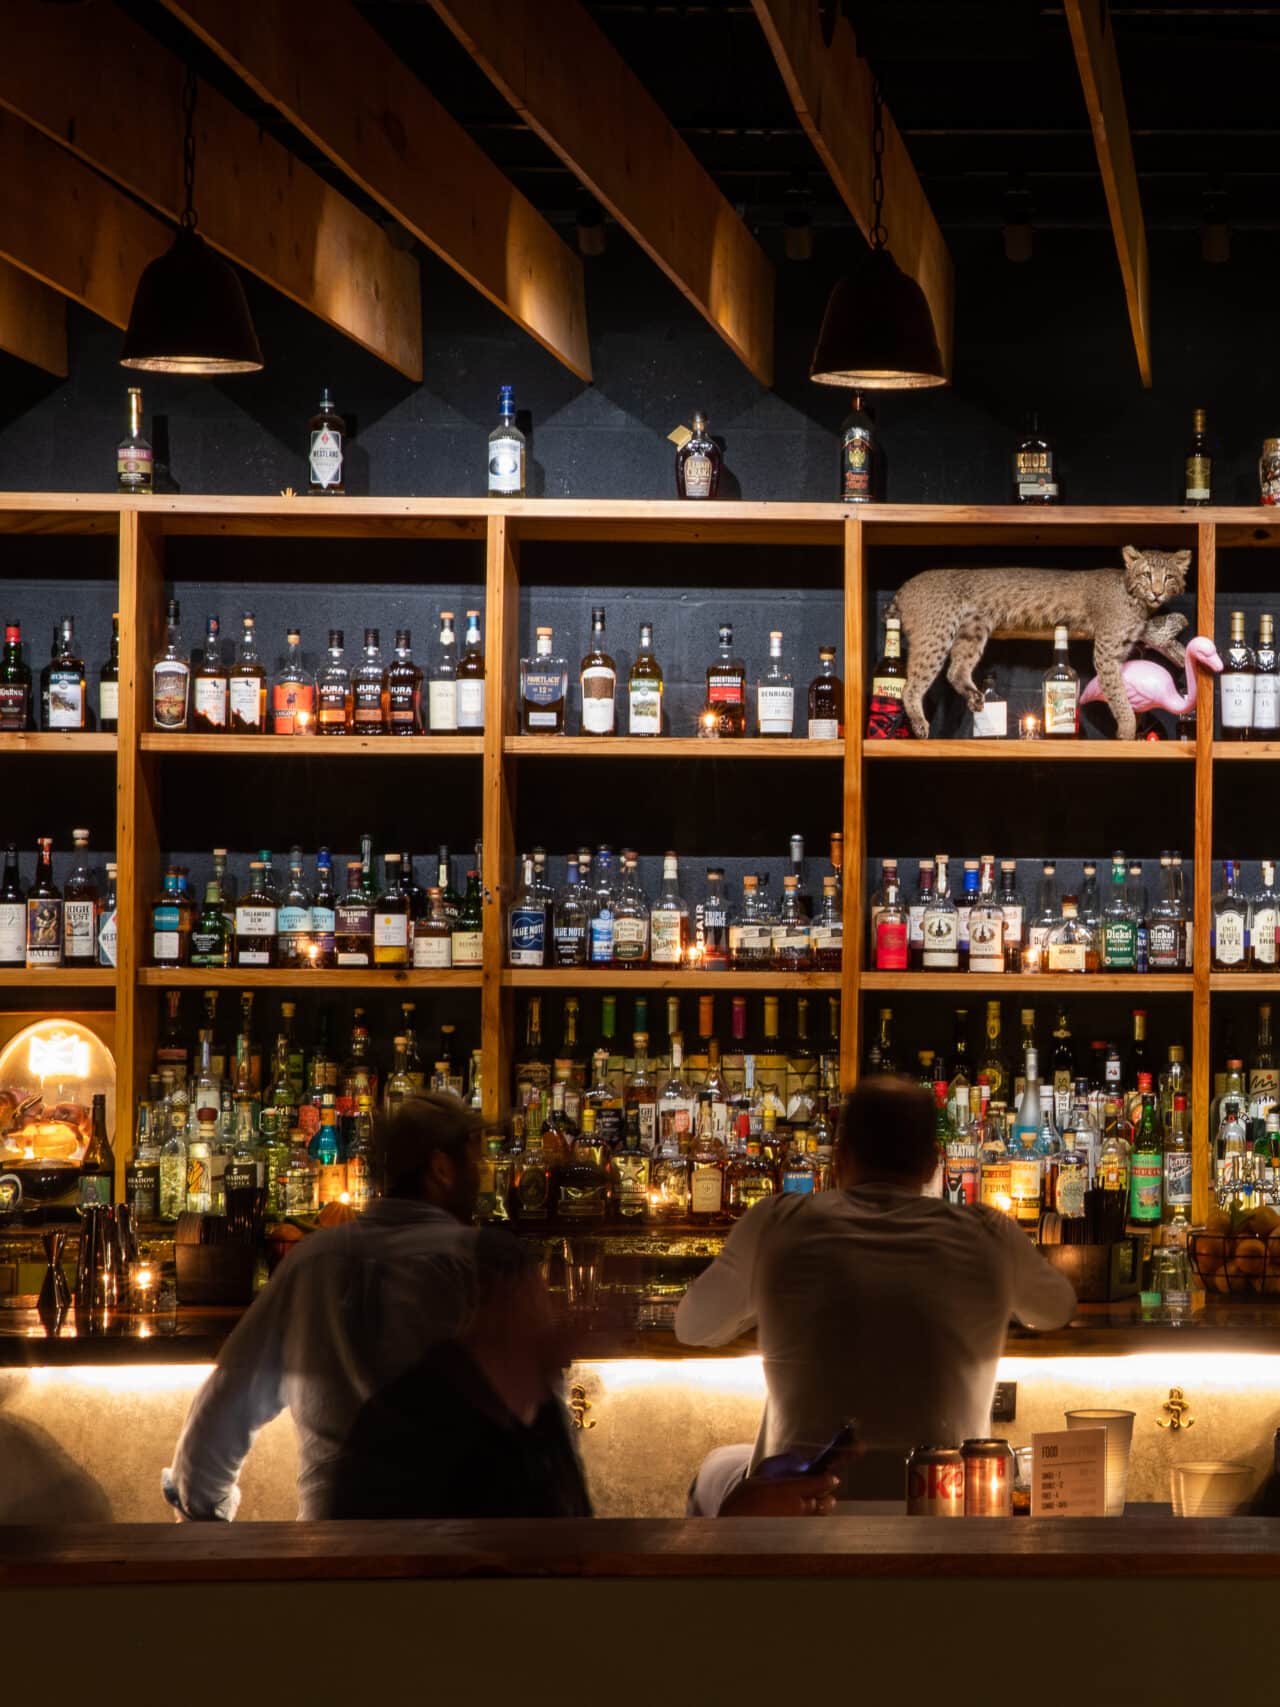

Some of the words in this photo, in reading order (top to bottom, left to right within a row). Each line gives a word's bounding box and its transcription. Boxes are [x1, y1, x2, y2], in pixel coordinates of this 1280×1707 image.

[1017, 453, 1047, 467] KNOB
[321, 685, 344, 693] JURA
[357, 684, 380, 693] JURA
[512, 926, 529, 937] BLUE
[529, 923, 544, 934] NOTE
[569, 927, 585, 937] NOTE
[1106, 929, 1131, 939] Dickel
[1150, 929, 1174, 939] Dickel
[102, 932, 117, 941] WEST
[984, 1184, 1010, 1193] FERN
[1042, 1445, 1058, 1459] FOOD
